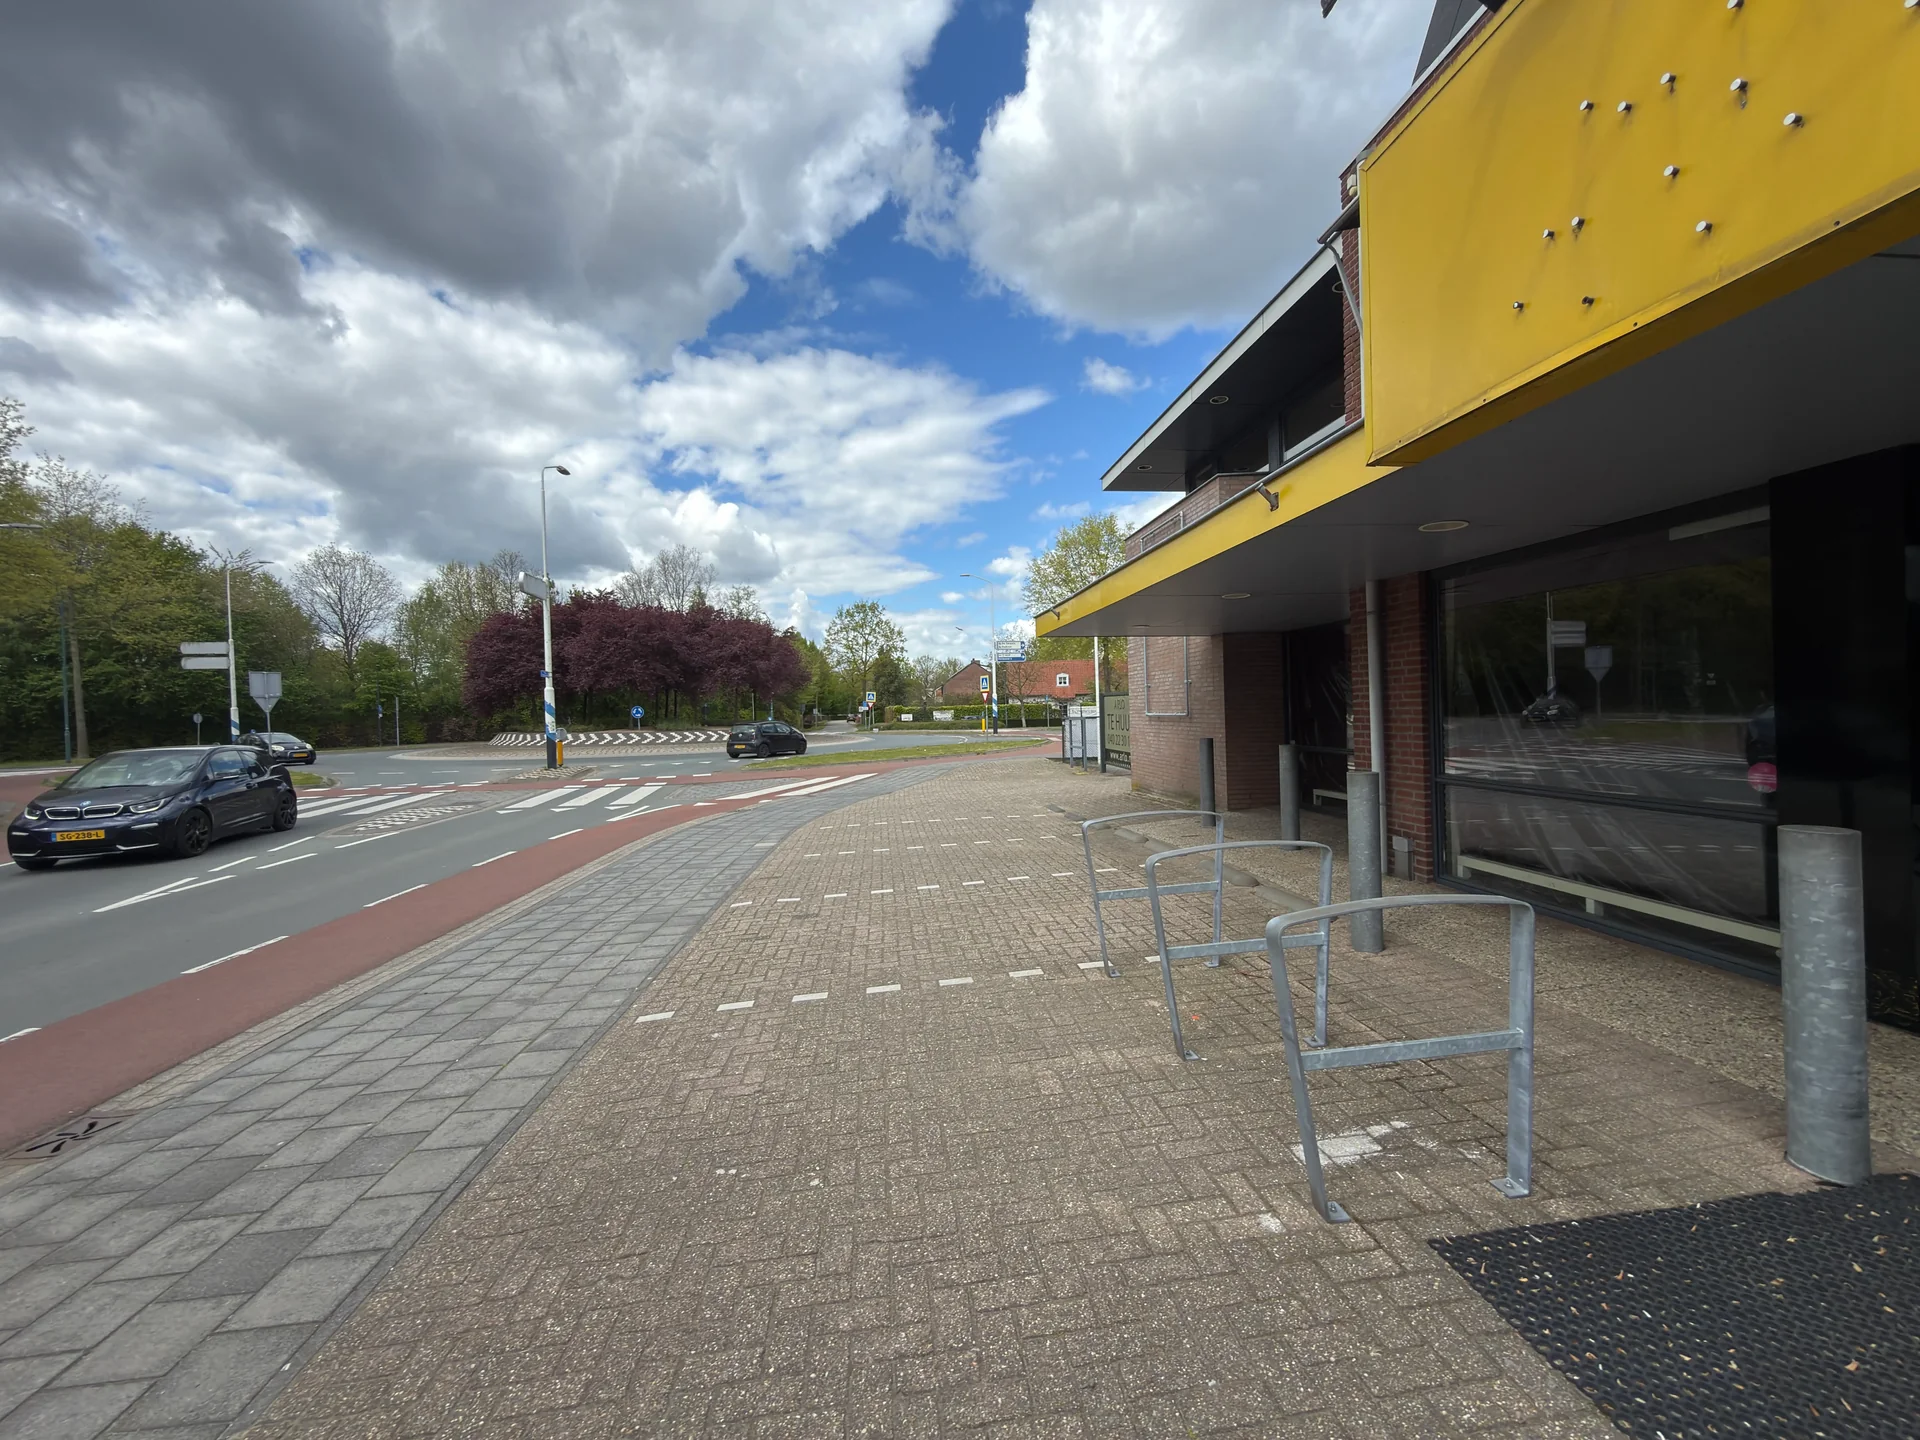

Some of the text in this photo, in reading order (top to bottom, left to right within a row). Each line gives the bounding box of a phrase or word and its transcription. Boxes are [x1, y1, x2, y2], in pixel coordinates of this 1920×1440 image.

[1107, 714, 1114, 731] TE
[1115, 734, 1121, 746] 22
[60, 831, 102, 840] SG-238-L
